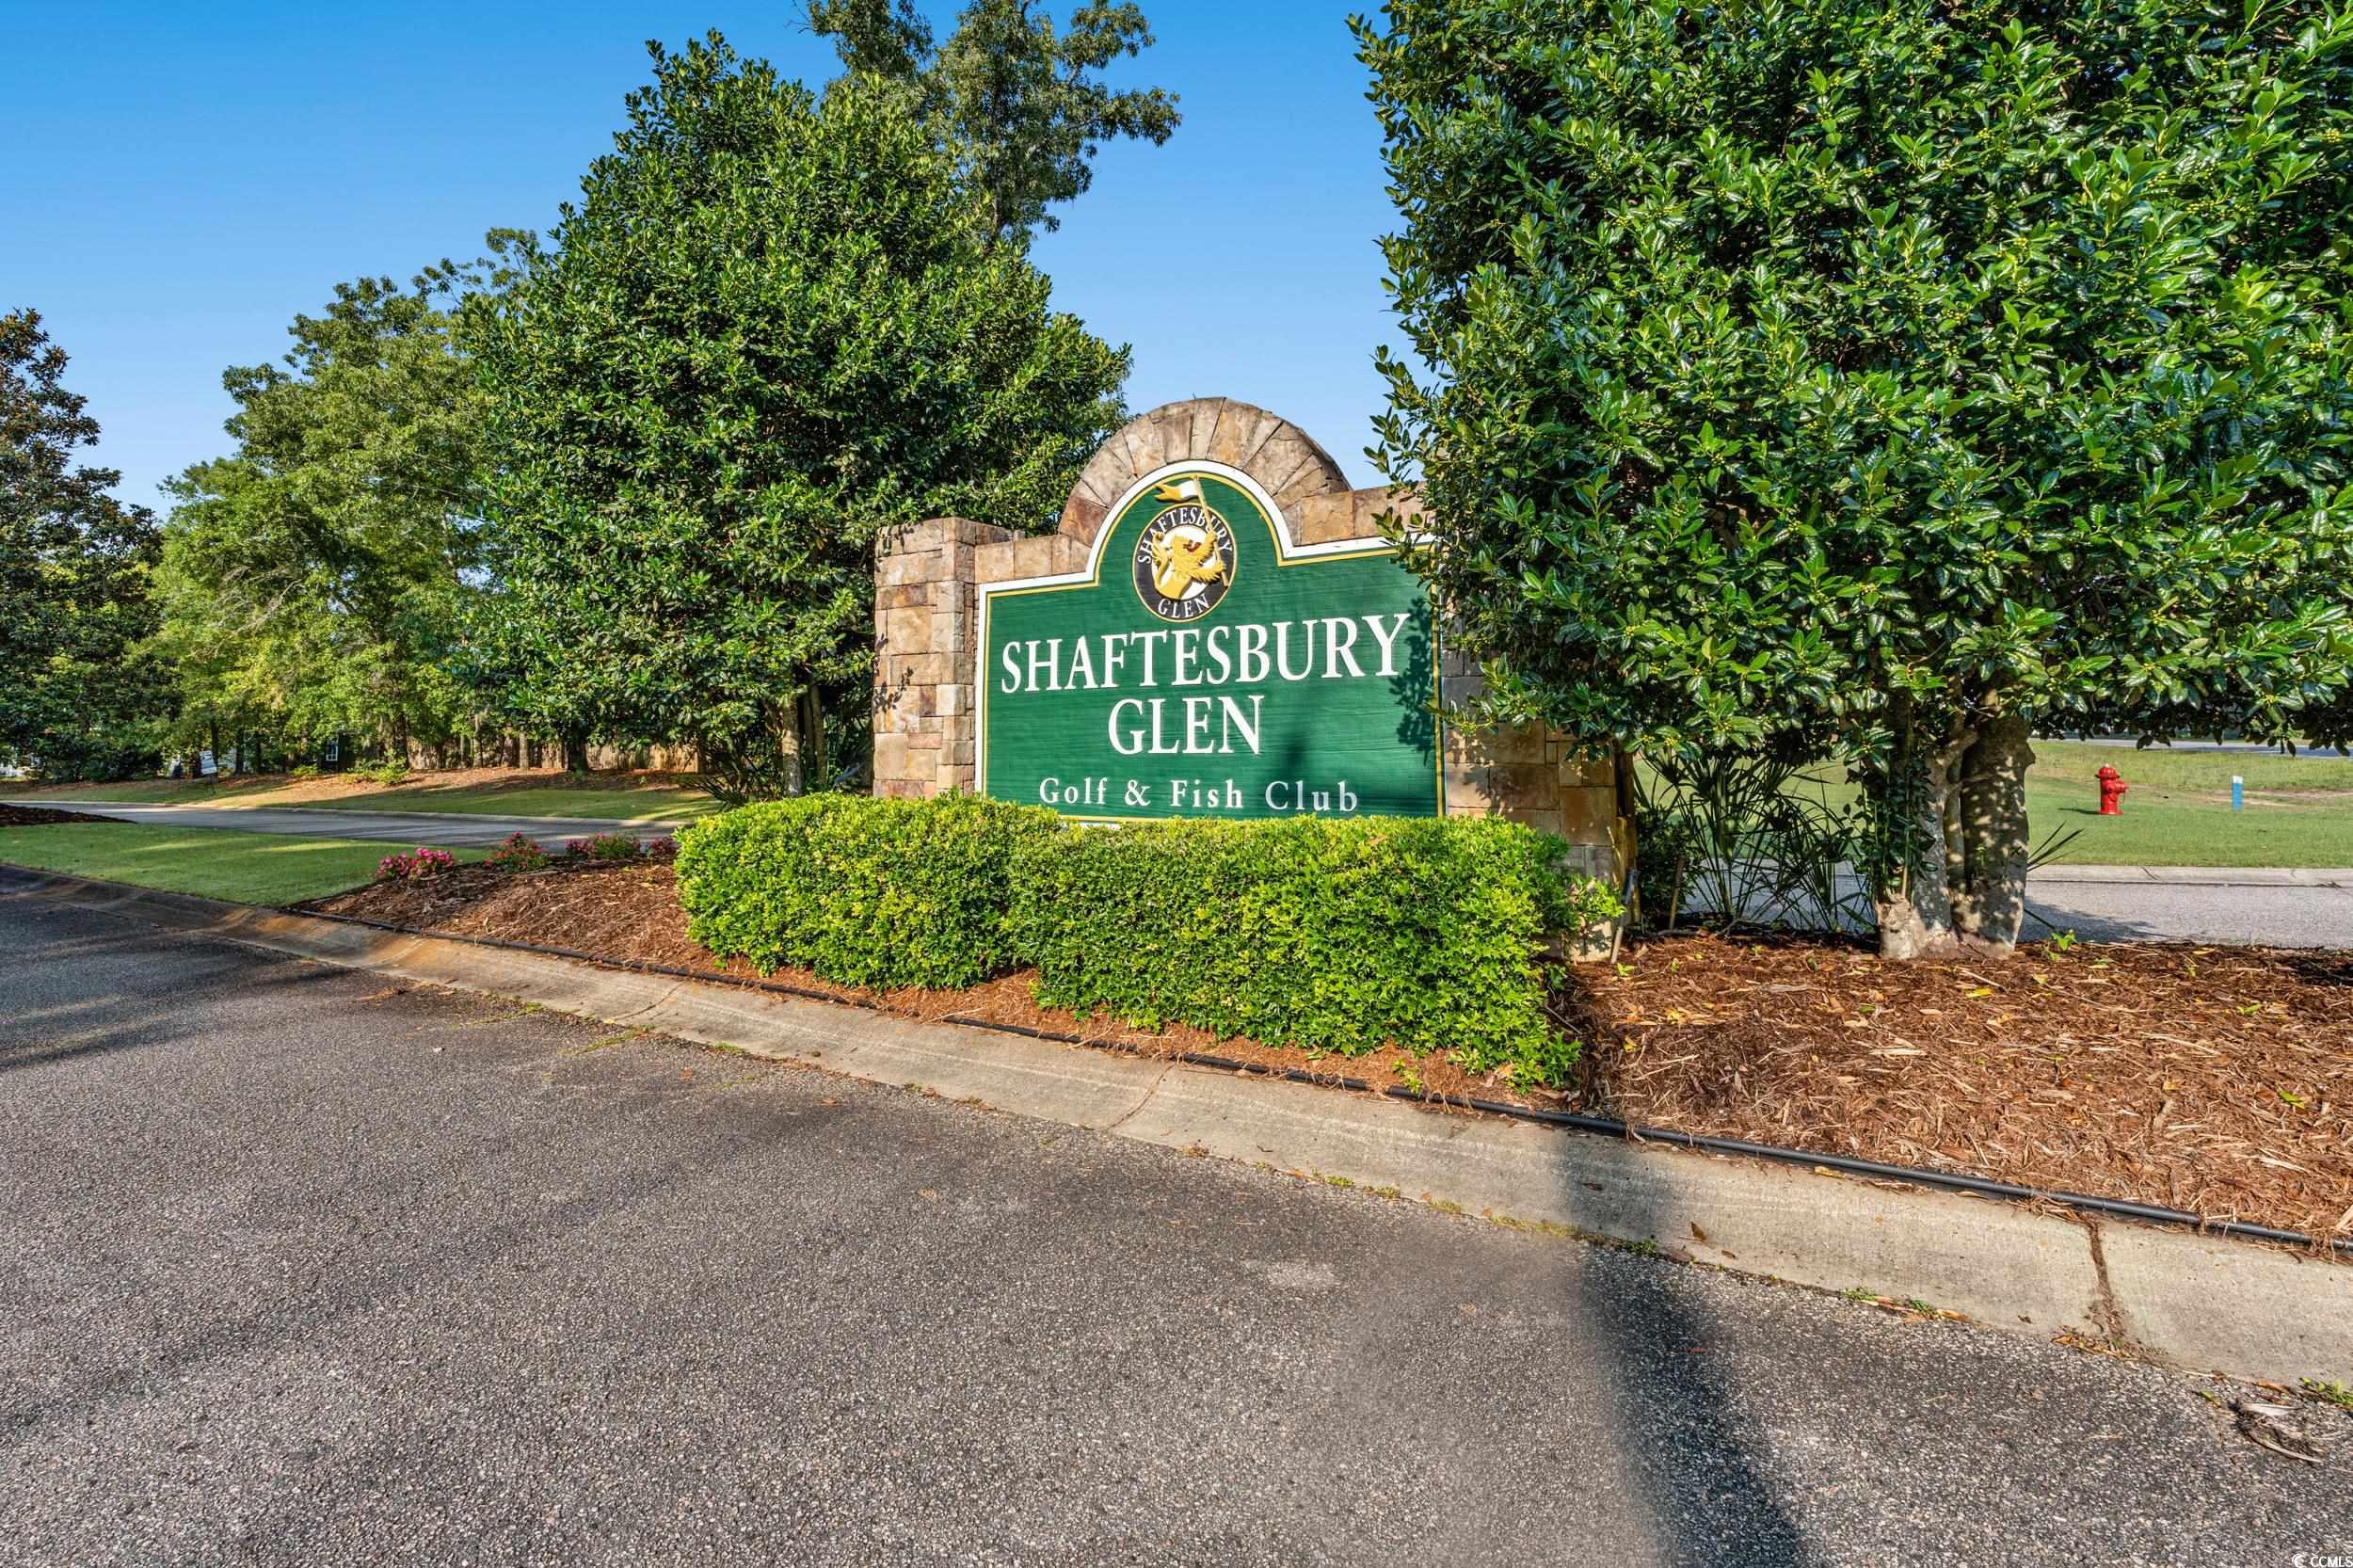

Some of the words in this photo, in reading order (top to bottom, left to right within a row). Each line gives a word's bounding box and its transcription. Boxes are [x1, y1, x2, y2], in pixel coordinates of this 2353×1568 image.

[1158, 594, 1210, 617] GLEN
[1000, 613, 1411, 694] SHAFTESBURY
[1108, 695, 1265, 755] GLEN
[1039, 776, 1108, 805] Golf
[1125, 779, 1150, 807] &
[1171, 779, 1243, 808] Fish
[1265, 781, 1358, 812] Club
